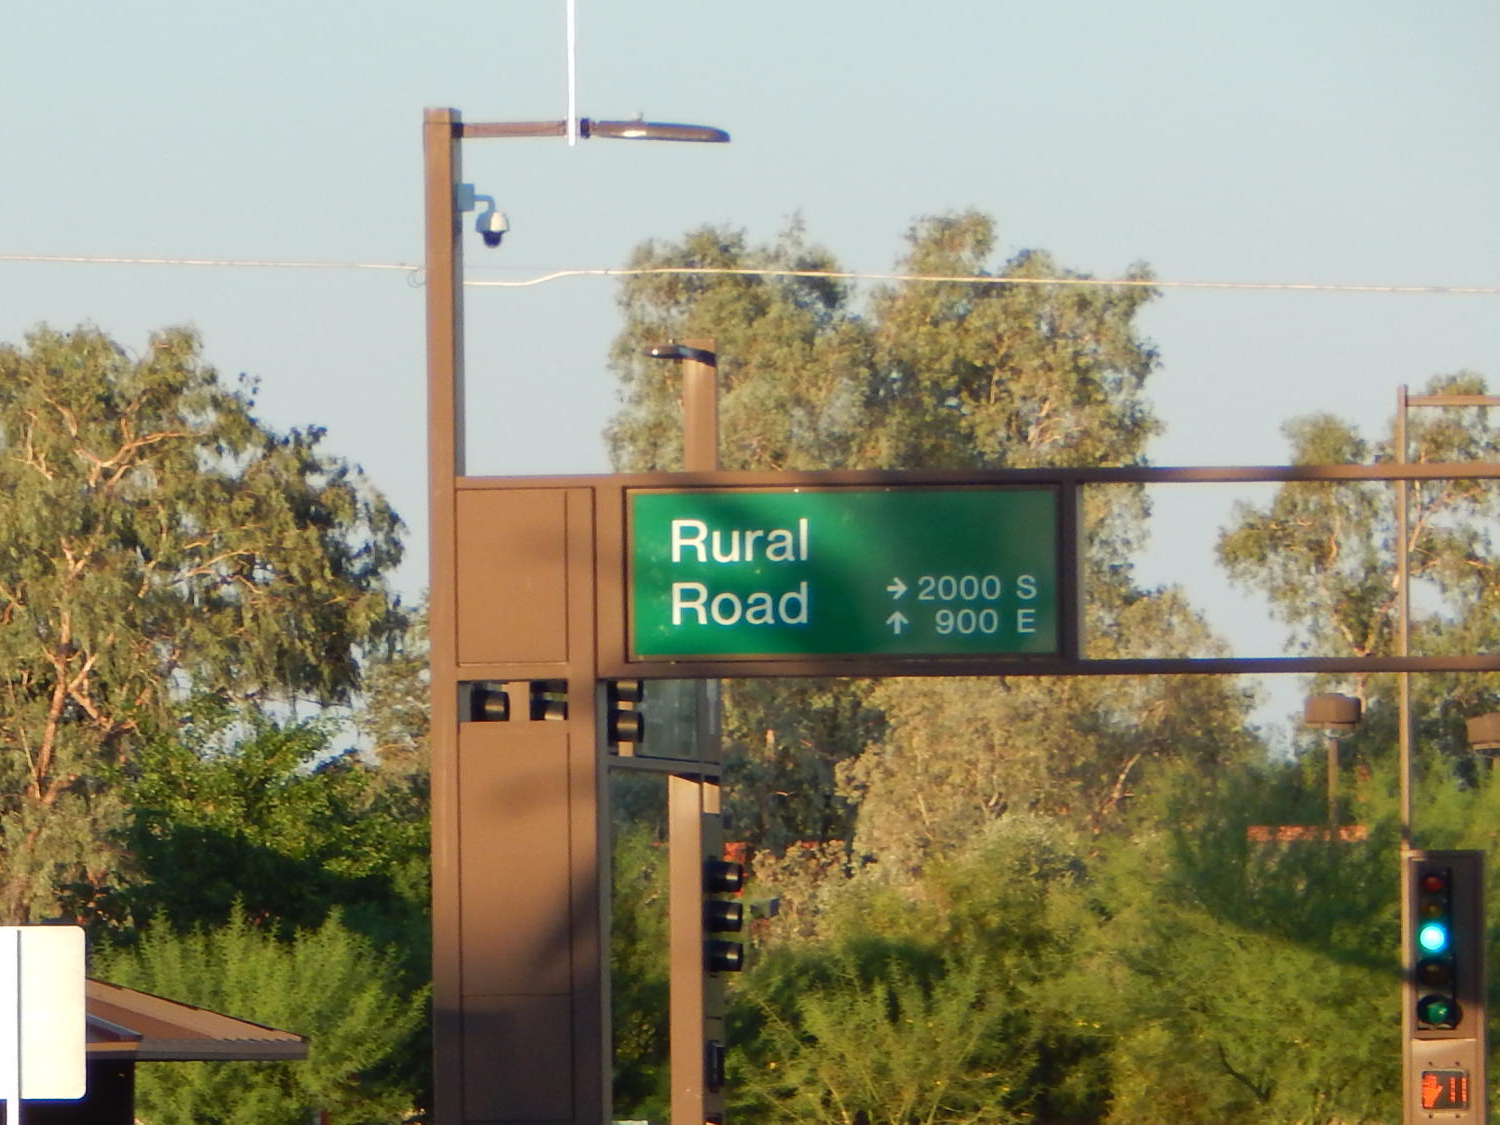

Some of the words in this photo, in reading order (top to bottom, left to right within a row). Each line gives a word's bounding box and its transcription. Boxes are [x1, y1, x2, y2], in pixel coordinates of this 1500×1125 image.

[670, 518, 809, 563] Rural
[670, 581, 809, 626] Road
[918, 575, 1002, 602] 2000
[1015, 574, 1039, 601] S
[935, 608, 1000, 635] 900
[1016, 608, 1037, 633] E
